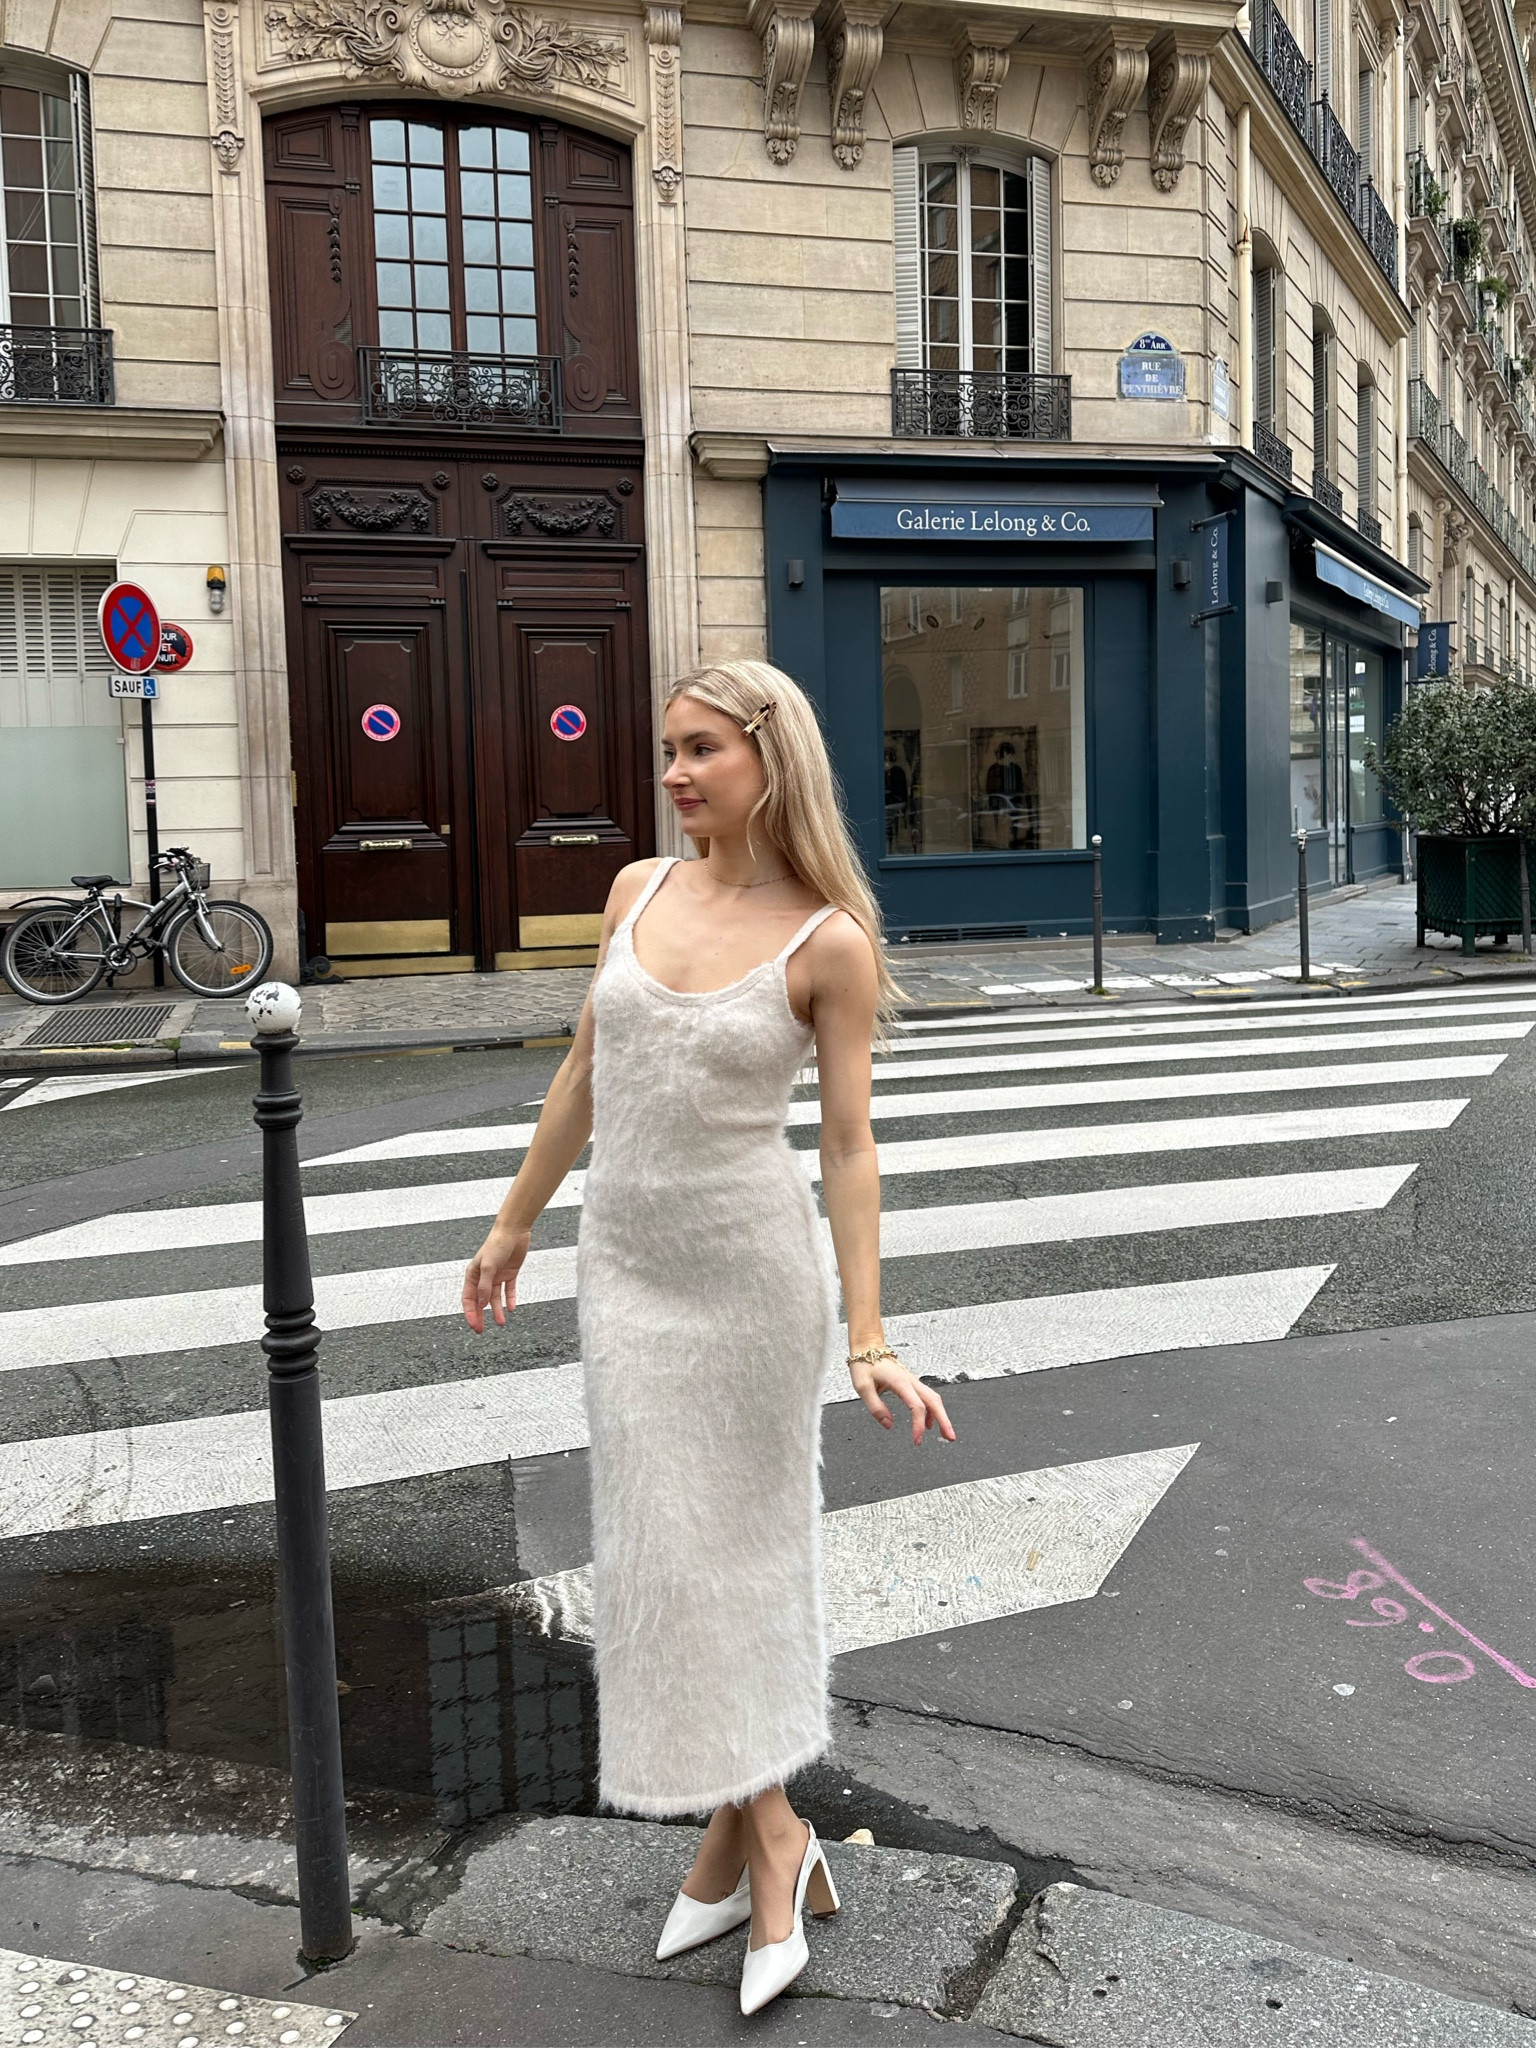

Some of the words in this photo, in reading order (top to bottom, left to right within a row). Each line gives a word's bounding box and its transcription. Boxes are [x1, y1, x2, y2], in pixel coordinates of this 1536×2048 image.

[1141, 361, 1161, 371] RUE
[1145, 373, 1159, 382] DE
[896, 508, 965, 531] Galerie
[970, 510, 1038, 537] Lelong
[1041, 514, 1056, 531] &
[1060, 511, 1091, 532] Co.
[1211, 549, 1218, 560] &
[1210, 560, 1220, 605] Lelong
[161, 632, 178, 641] OUR
[161, 643, 172, 652] ET
[158, 654, 176, 662] NUIT
[114, 680, 142, 693] SAUF
